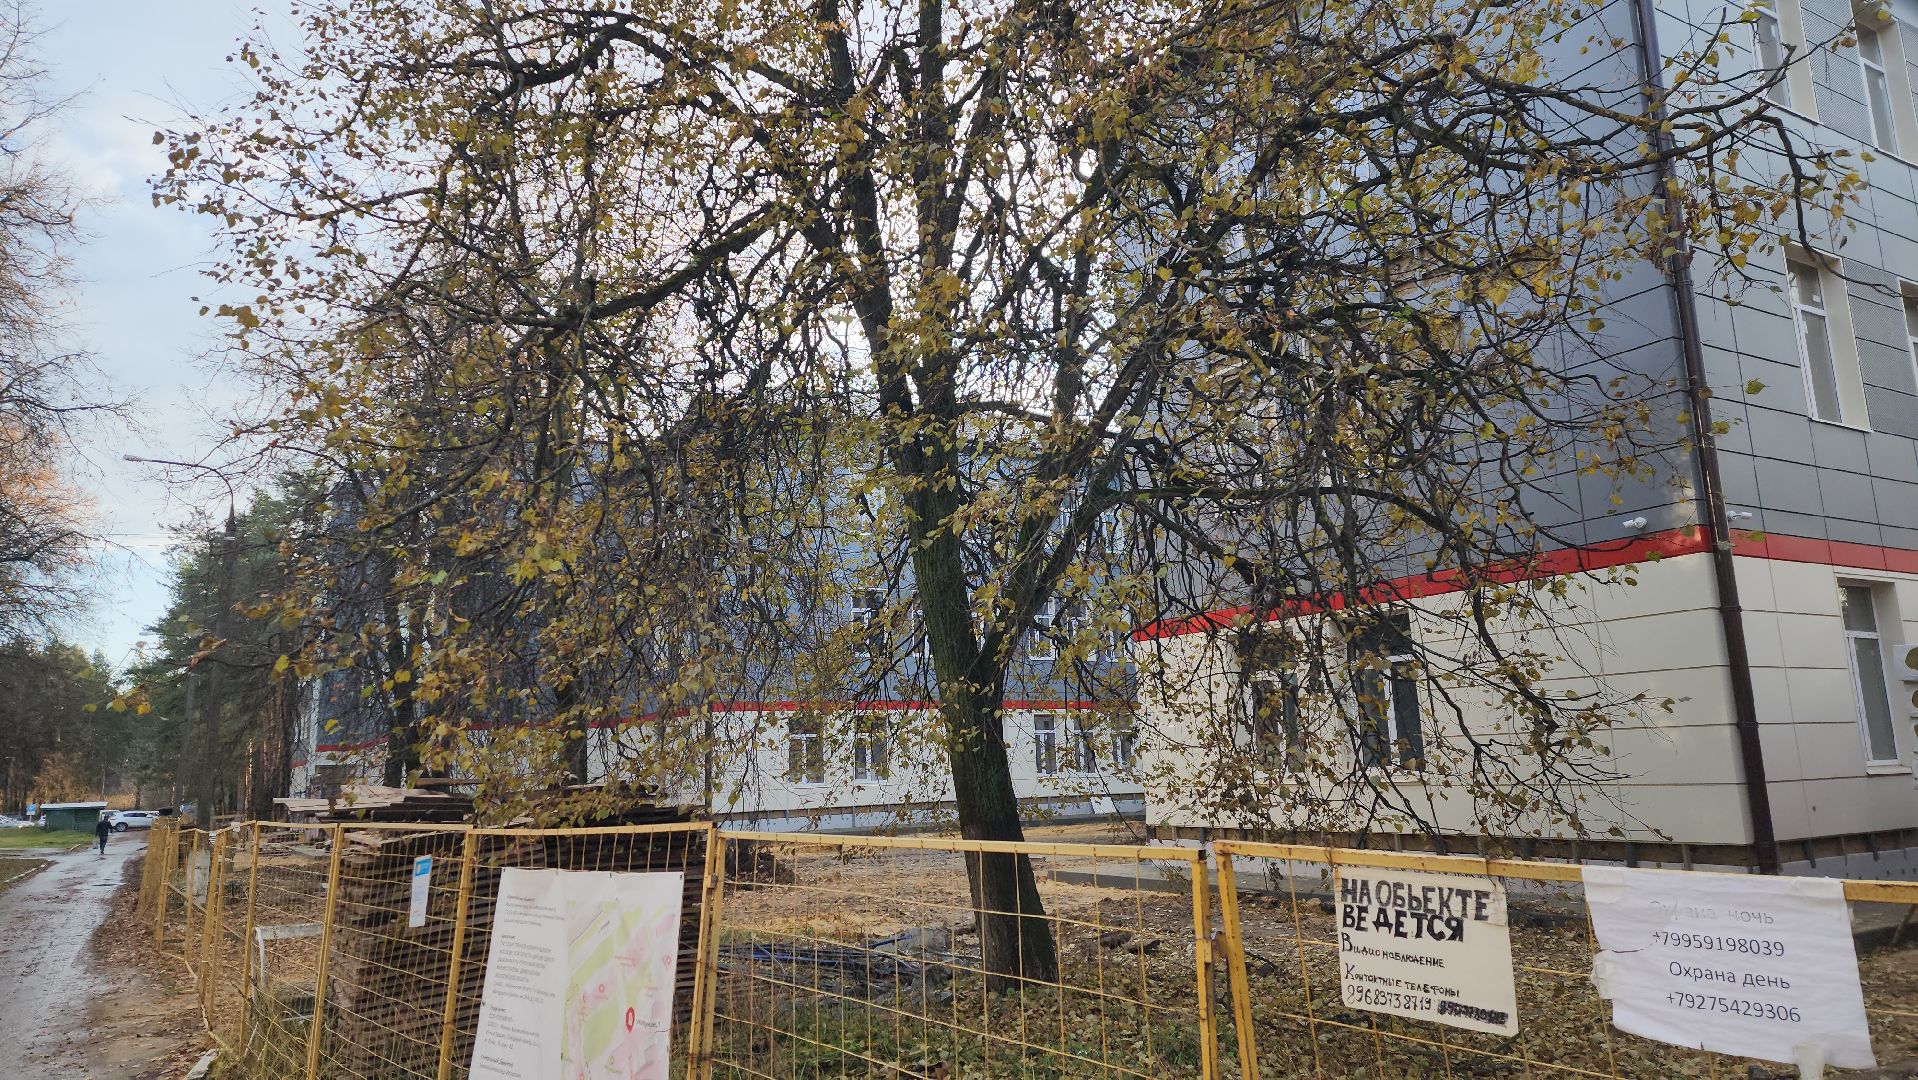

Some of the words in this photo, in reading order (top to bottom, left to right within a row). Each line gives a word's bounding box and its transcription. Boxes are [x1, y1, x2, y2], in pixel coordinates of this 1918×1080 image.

[1341, 878, 1372, 905] НА
[1728, 908, 1775, 925] ночь
[1653, 931, 1785, 957] +79959198039
[1669, 961, 1736, 983] Охрана
[1742, 973, 1791, 989] день
[1666, 991, 1801, 1023] +79275429306
